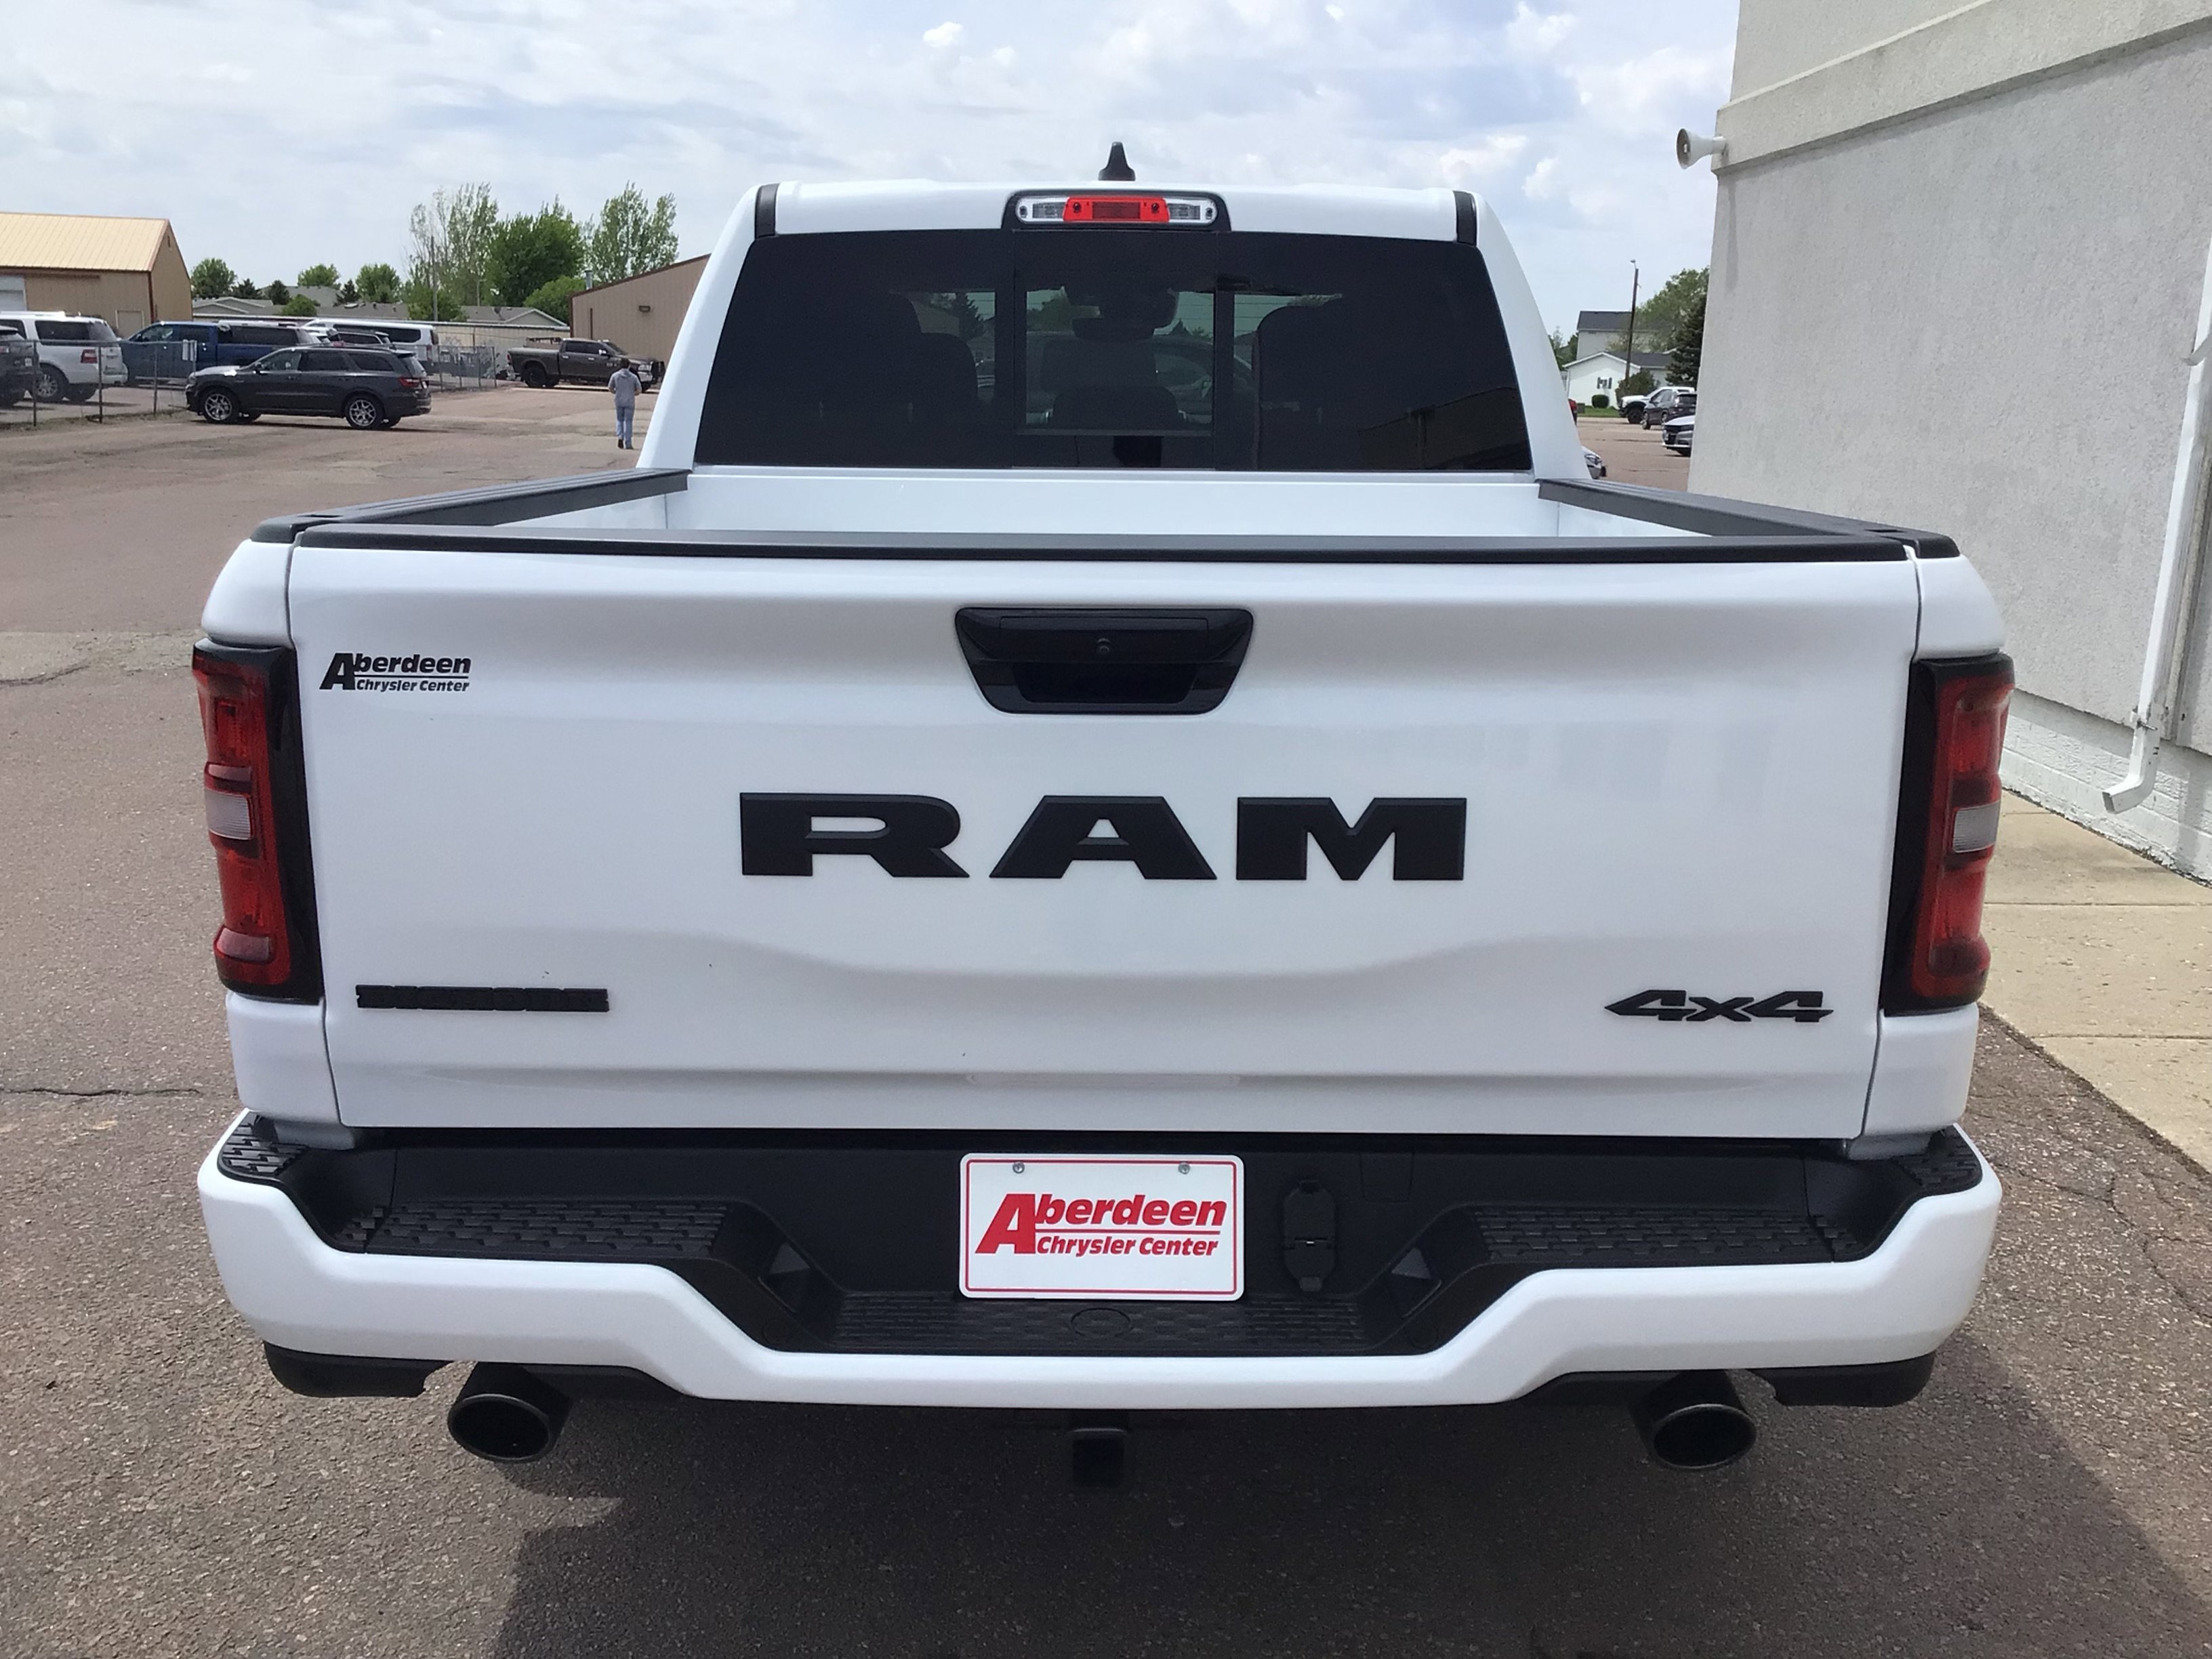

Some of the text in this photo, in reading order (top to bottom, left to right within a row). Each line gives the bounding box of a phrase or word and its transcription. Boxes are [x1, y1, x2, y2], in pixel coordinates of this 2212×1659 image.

[319, 653, 472, 690] Aberdeen
[356, 679, 470, 692] Chrysler Center
[740, 792, 1467, 881] RAM
[1604, 989, 1834, 1022] 4x4
[975, 1193, 1227, 1254] Aberdeen
[1037, 1236, 1218, 1257] Chrysler Center
